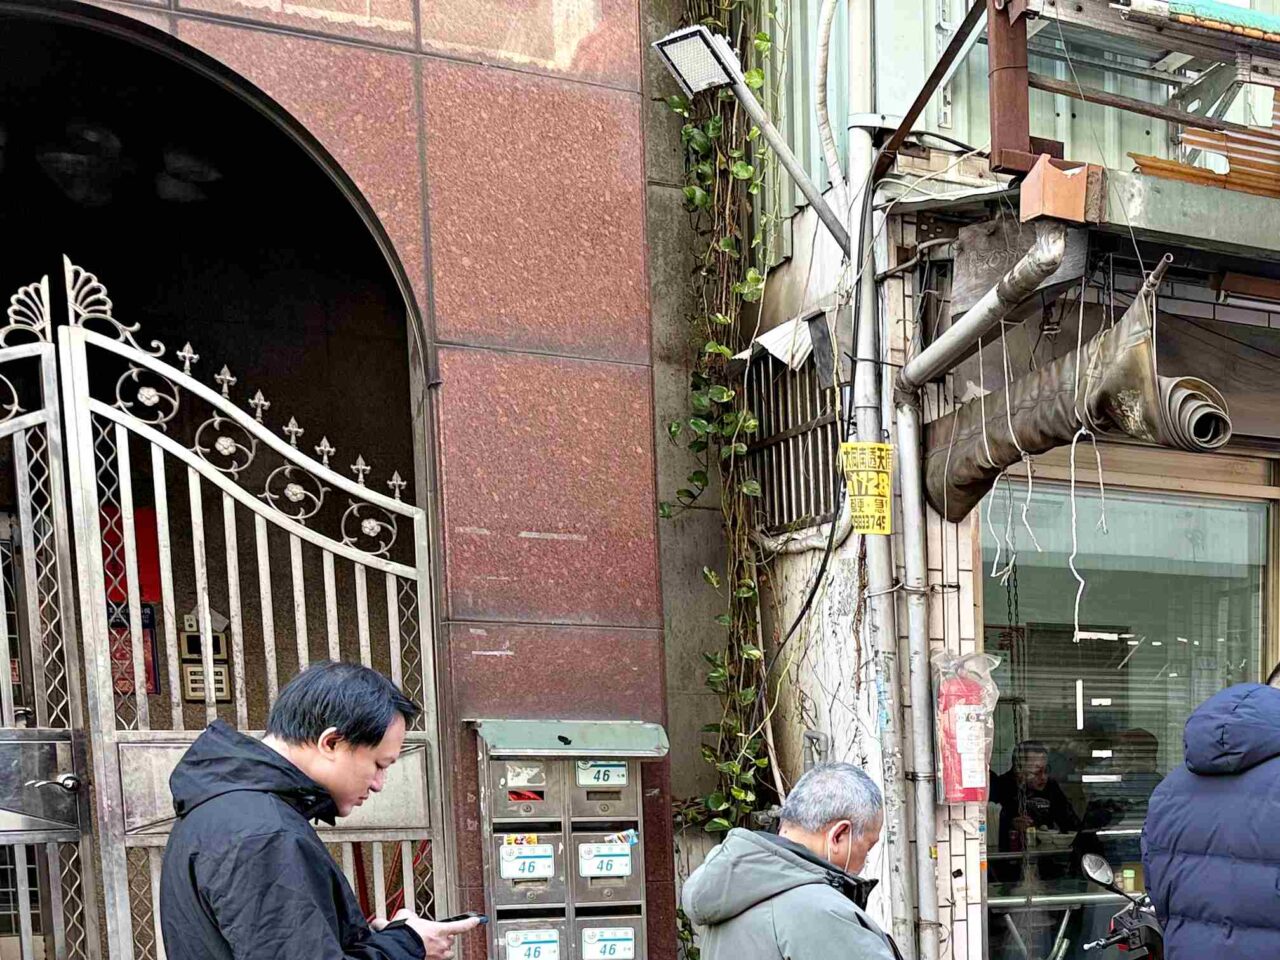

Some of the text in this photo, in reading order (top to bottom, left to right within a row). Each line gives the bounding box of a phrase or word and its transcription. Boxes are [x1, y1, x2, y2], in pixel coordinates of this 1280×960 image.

[593, 769, 611, 782] 46
[518, 860, 536, 873] 46
[596, 859, 614, 872] 46
[524, 946, 541, 959] 46
[600, 943, 617, 956] 46
